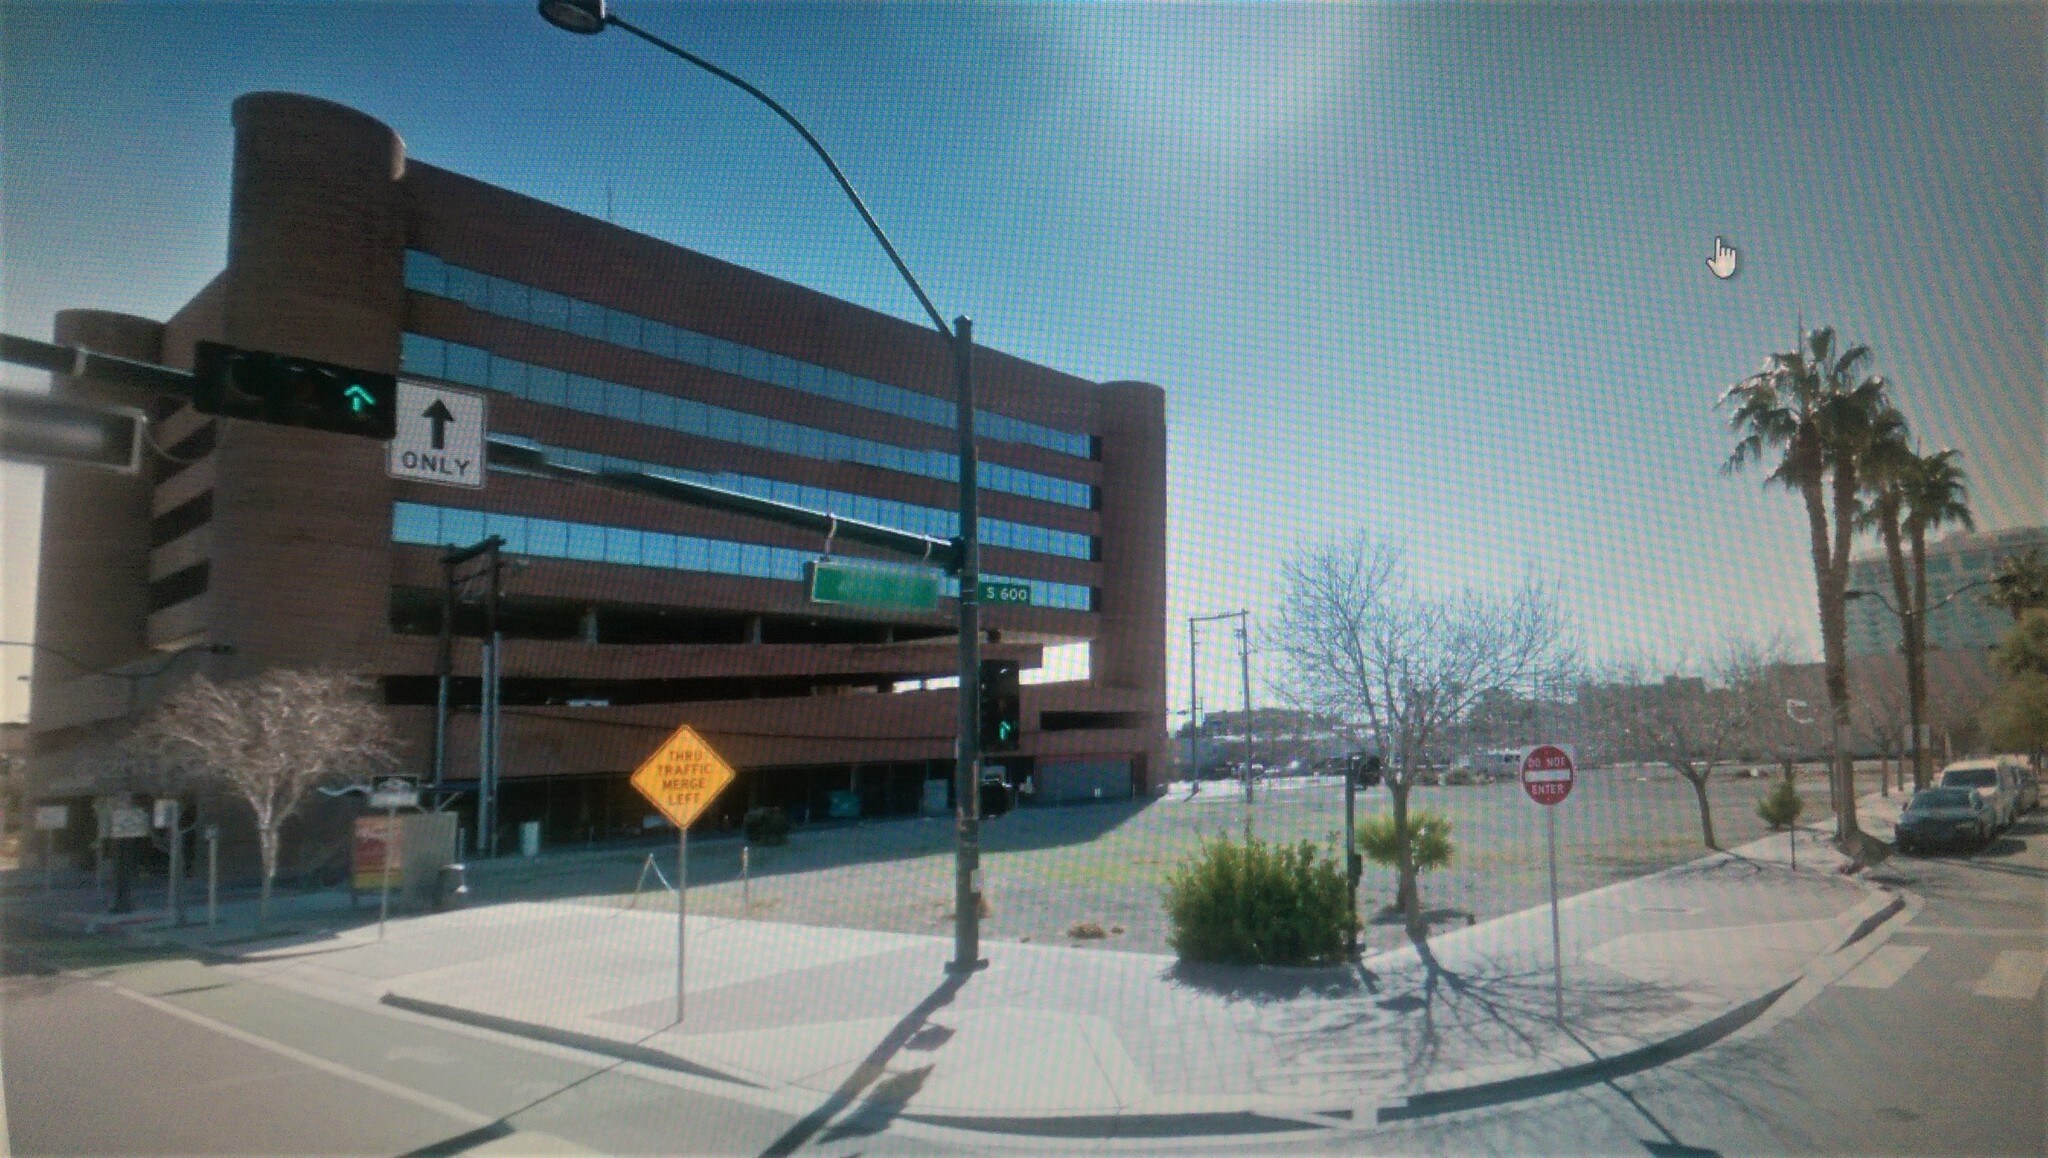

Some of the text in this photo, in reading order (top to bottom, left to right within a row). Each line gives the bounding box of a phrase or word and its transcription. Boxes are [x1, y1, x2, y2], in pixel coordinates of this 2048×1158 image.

[402, 451, 470, 476] ONLY
[986, 586, 1027, 601] S 600
[670, 751, 702, 761] THRU
[1528, 757, 1567, 767] DO NOT
[658, 763, 712, 775] TRAFFIC
[662, 780, 706, 790] MERGE
[1531, 783, 1565, 795] ENTER
[669, 793, 700, 805] LEFT
